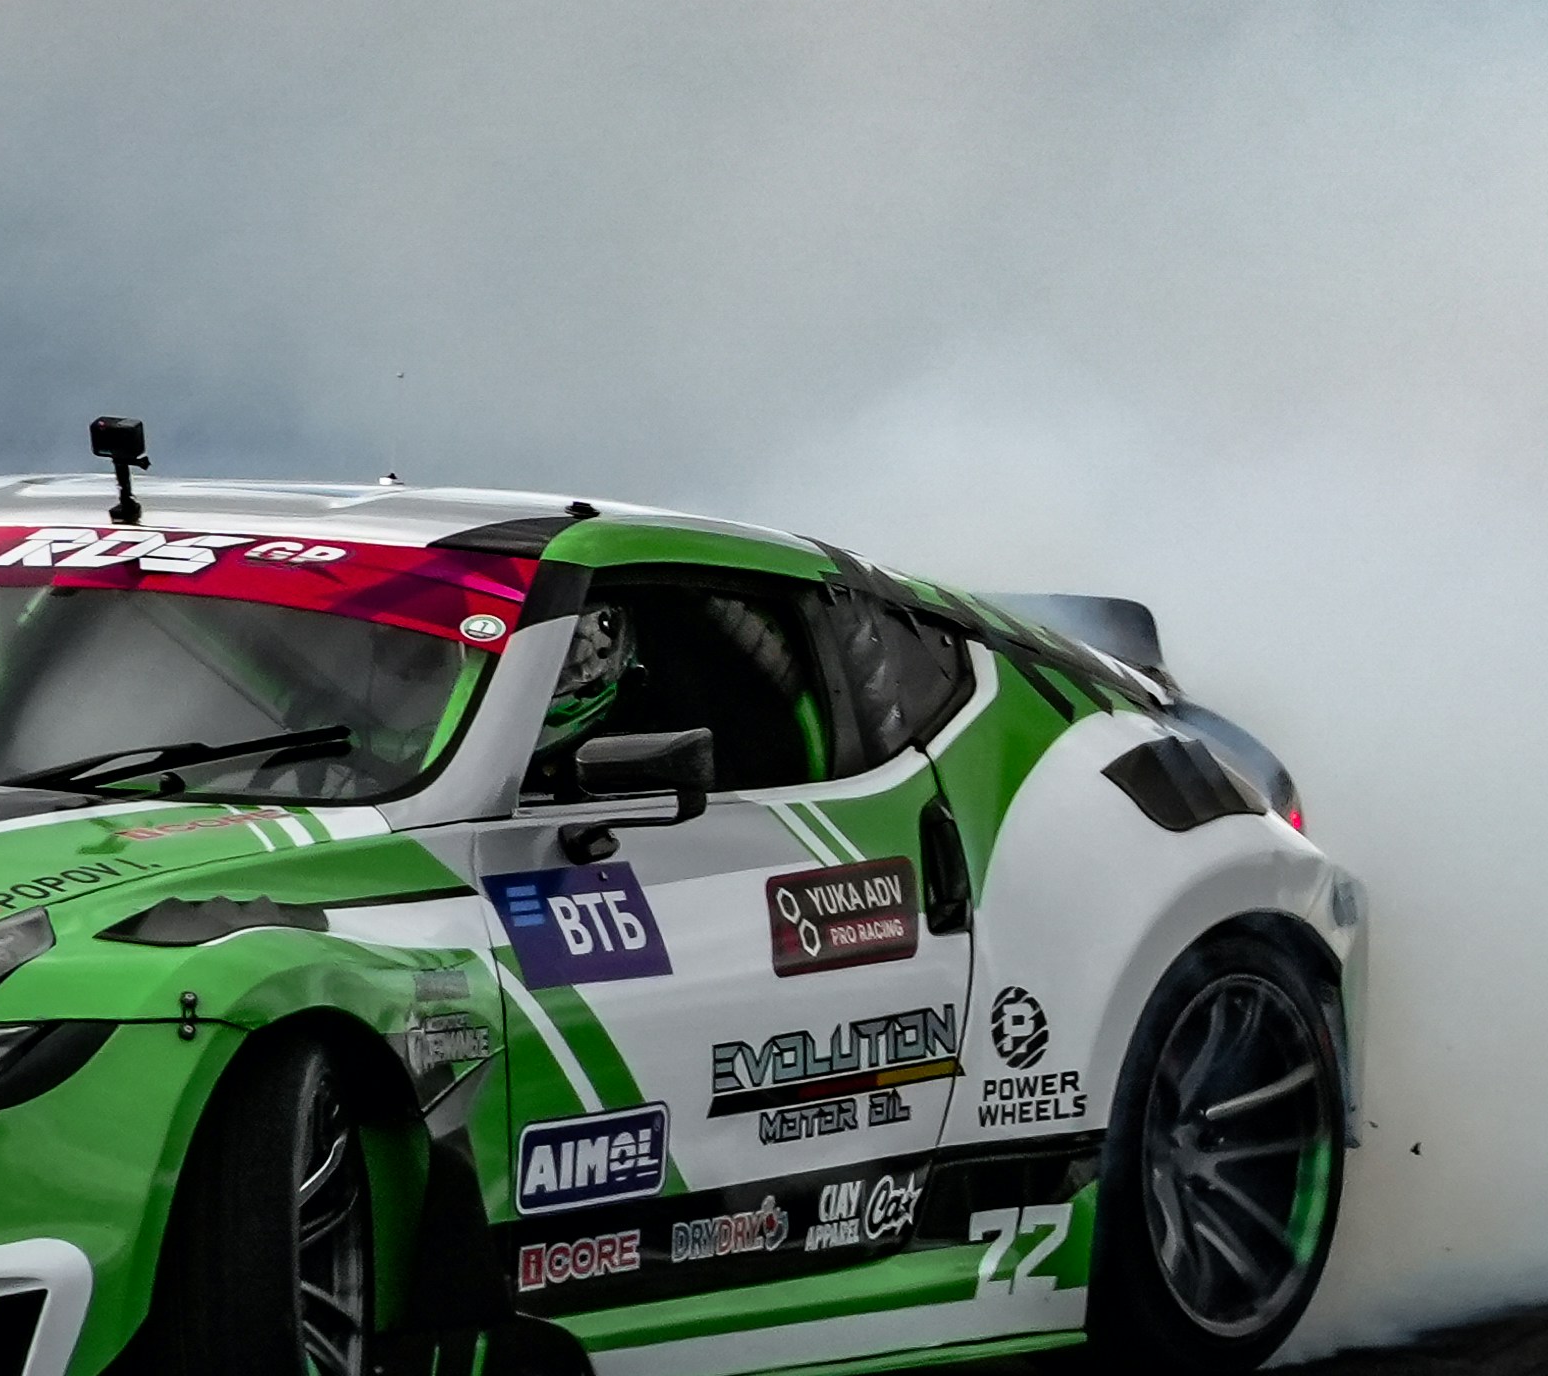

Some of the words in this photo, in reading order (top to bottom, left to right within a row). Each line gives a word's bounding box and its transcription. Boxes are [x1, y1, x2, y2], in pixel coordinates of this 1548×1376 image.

[243, 541, 346, 564] GP
[805, 882, 866, 916] YUKA
[863, 874, 903, 909] ADV
[550, 889, 648, 956] ВТБ
[829, 925, 857, 947] PRO
[857, 918, 905, 942] RACING
[712, 1003, 957, 1094] EVOLUTION
[983, 1070, 1081, 1102] POWER
[758, 1098, 859, 1145] MOTOR
[868, 1087, 912, 1127] OIL
[978, 1094, 1088, 1128] WHEELS
[522, 1128, 660, 1196] AIMOL
